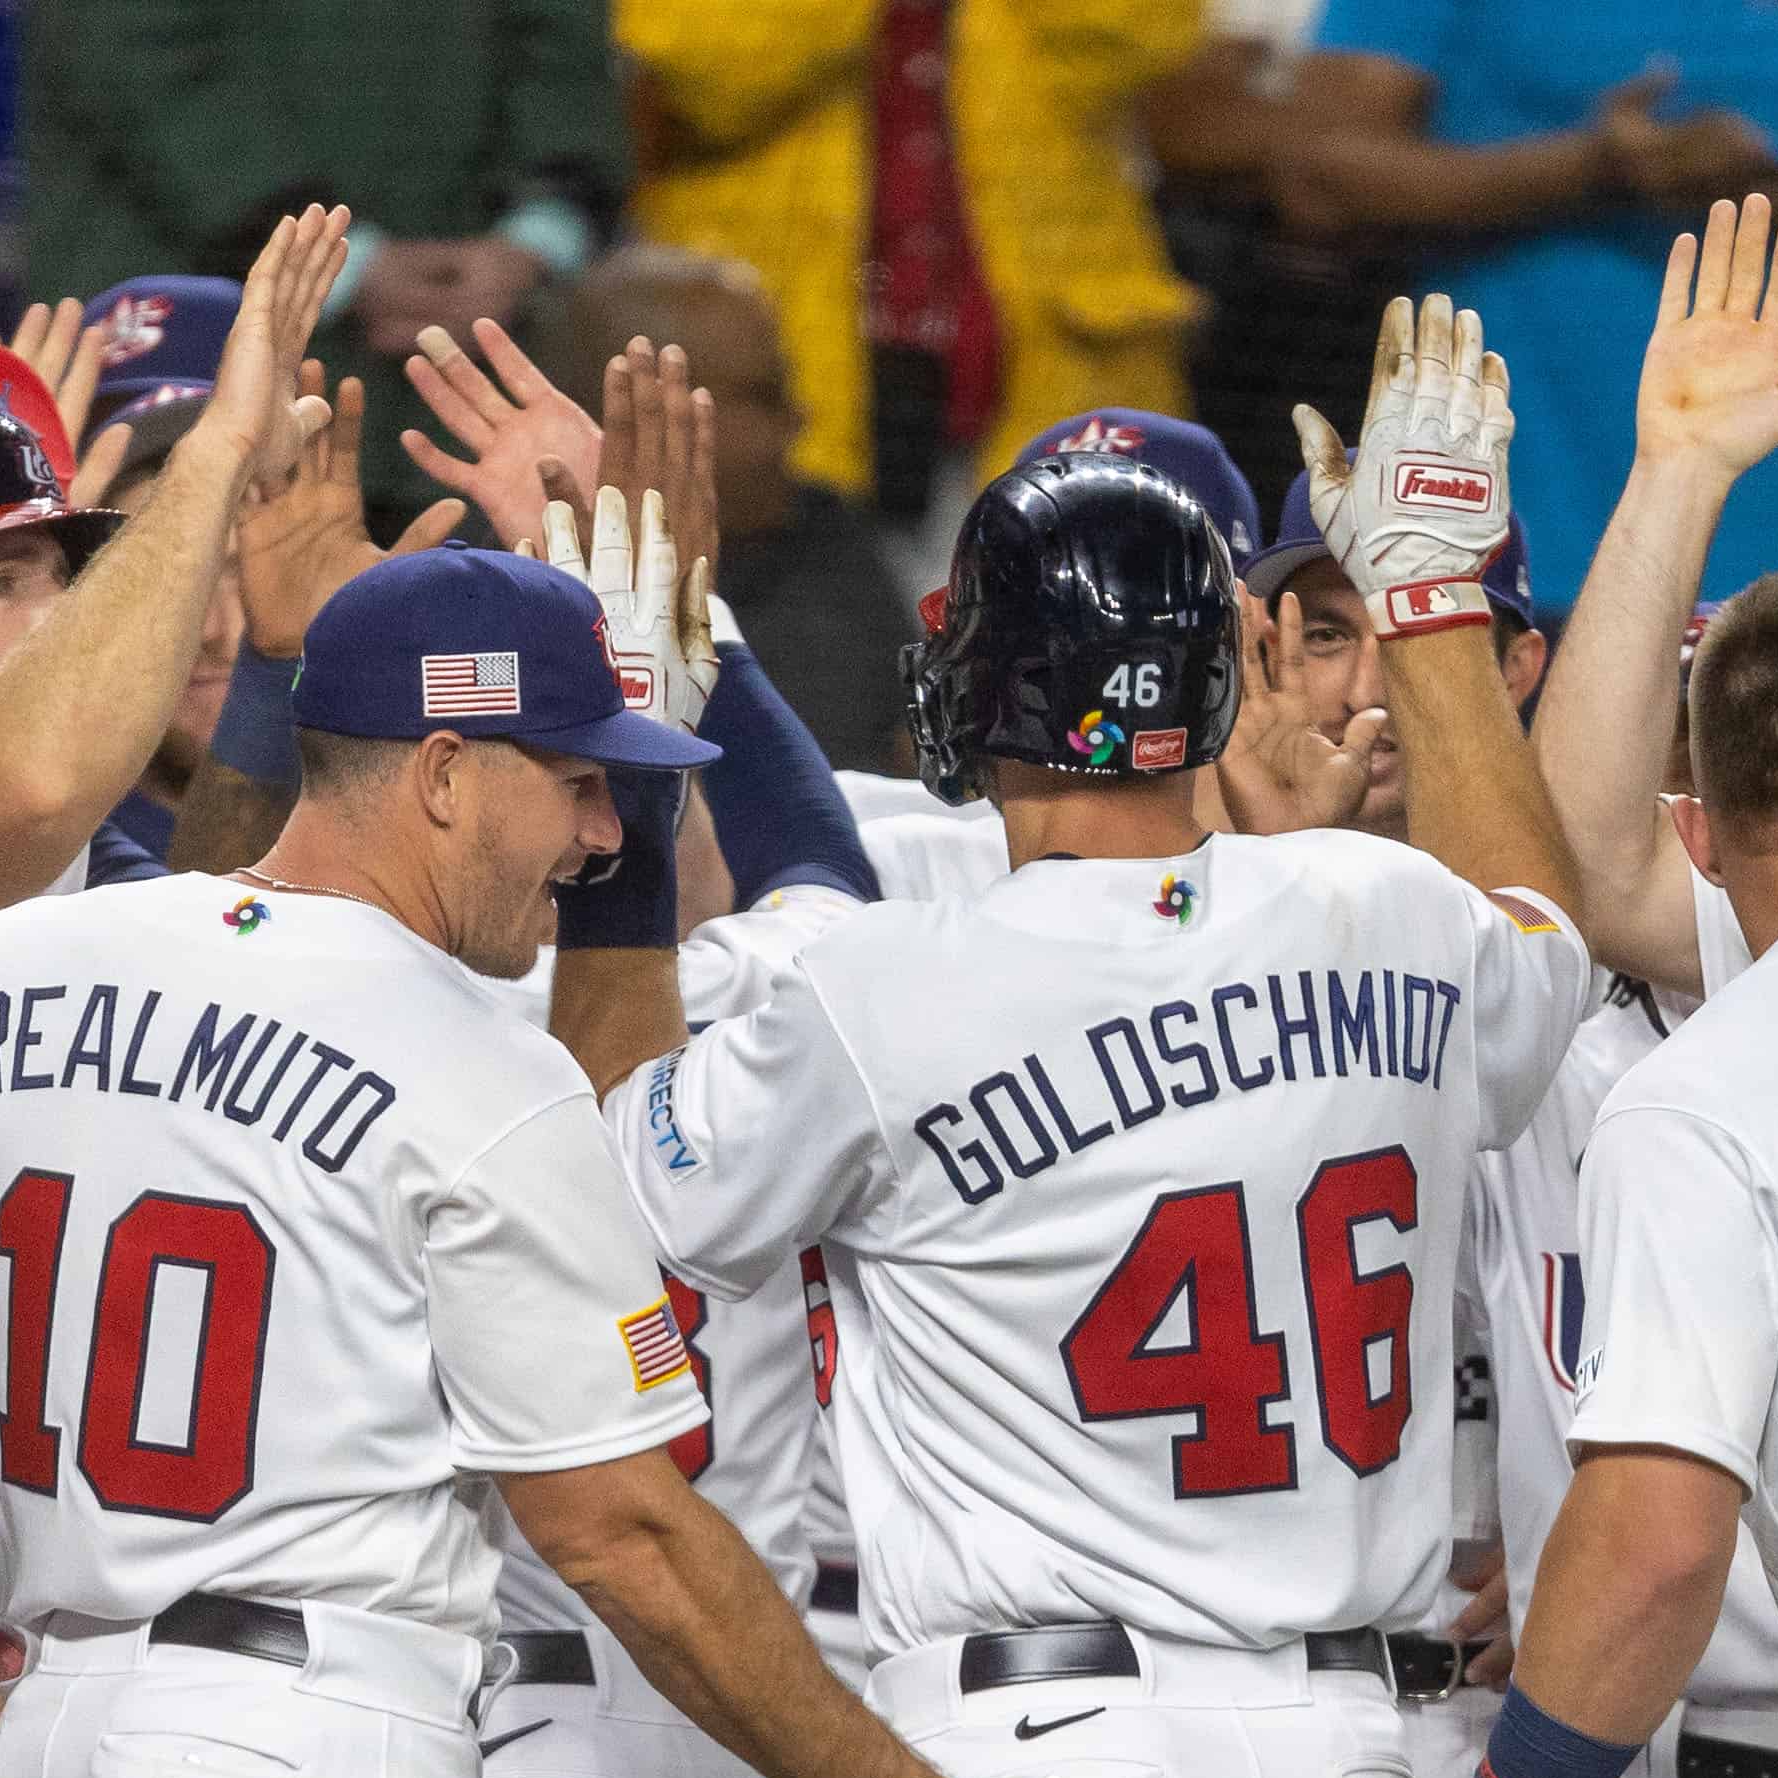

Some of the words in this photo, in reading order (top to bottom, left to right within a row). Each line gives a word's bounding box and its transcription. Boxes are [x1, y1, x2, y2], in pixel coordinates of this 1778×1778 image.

[1400, 468, 1487, 503] Franklin
[1102, 663, 1163, 708] 46
[914, 968, 1460, 1206] GOLDSCHMIDT
[1059, 1144, 1419, 1500] 46
